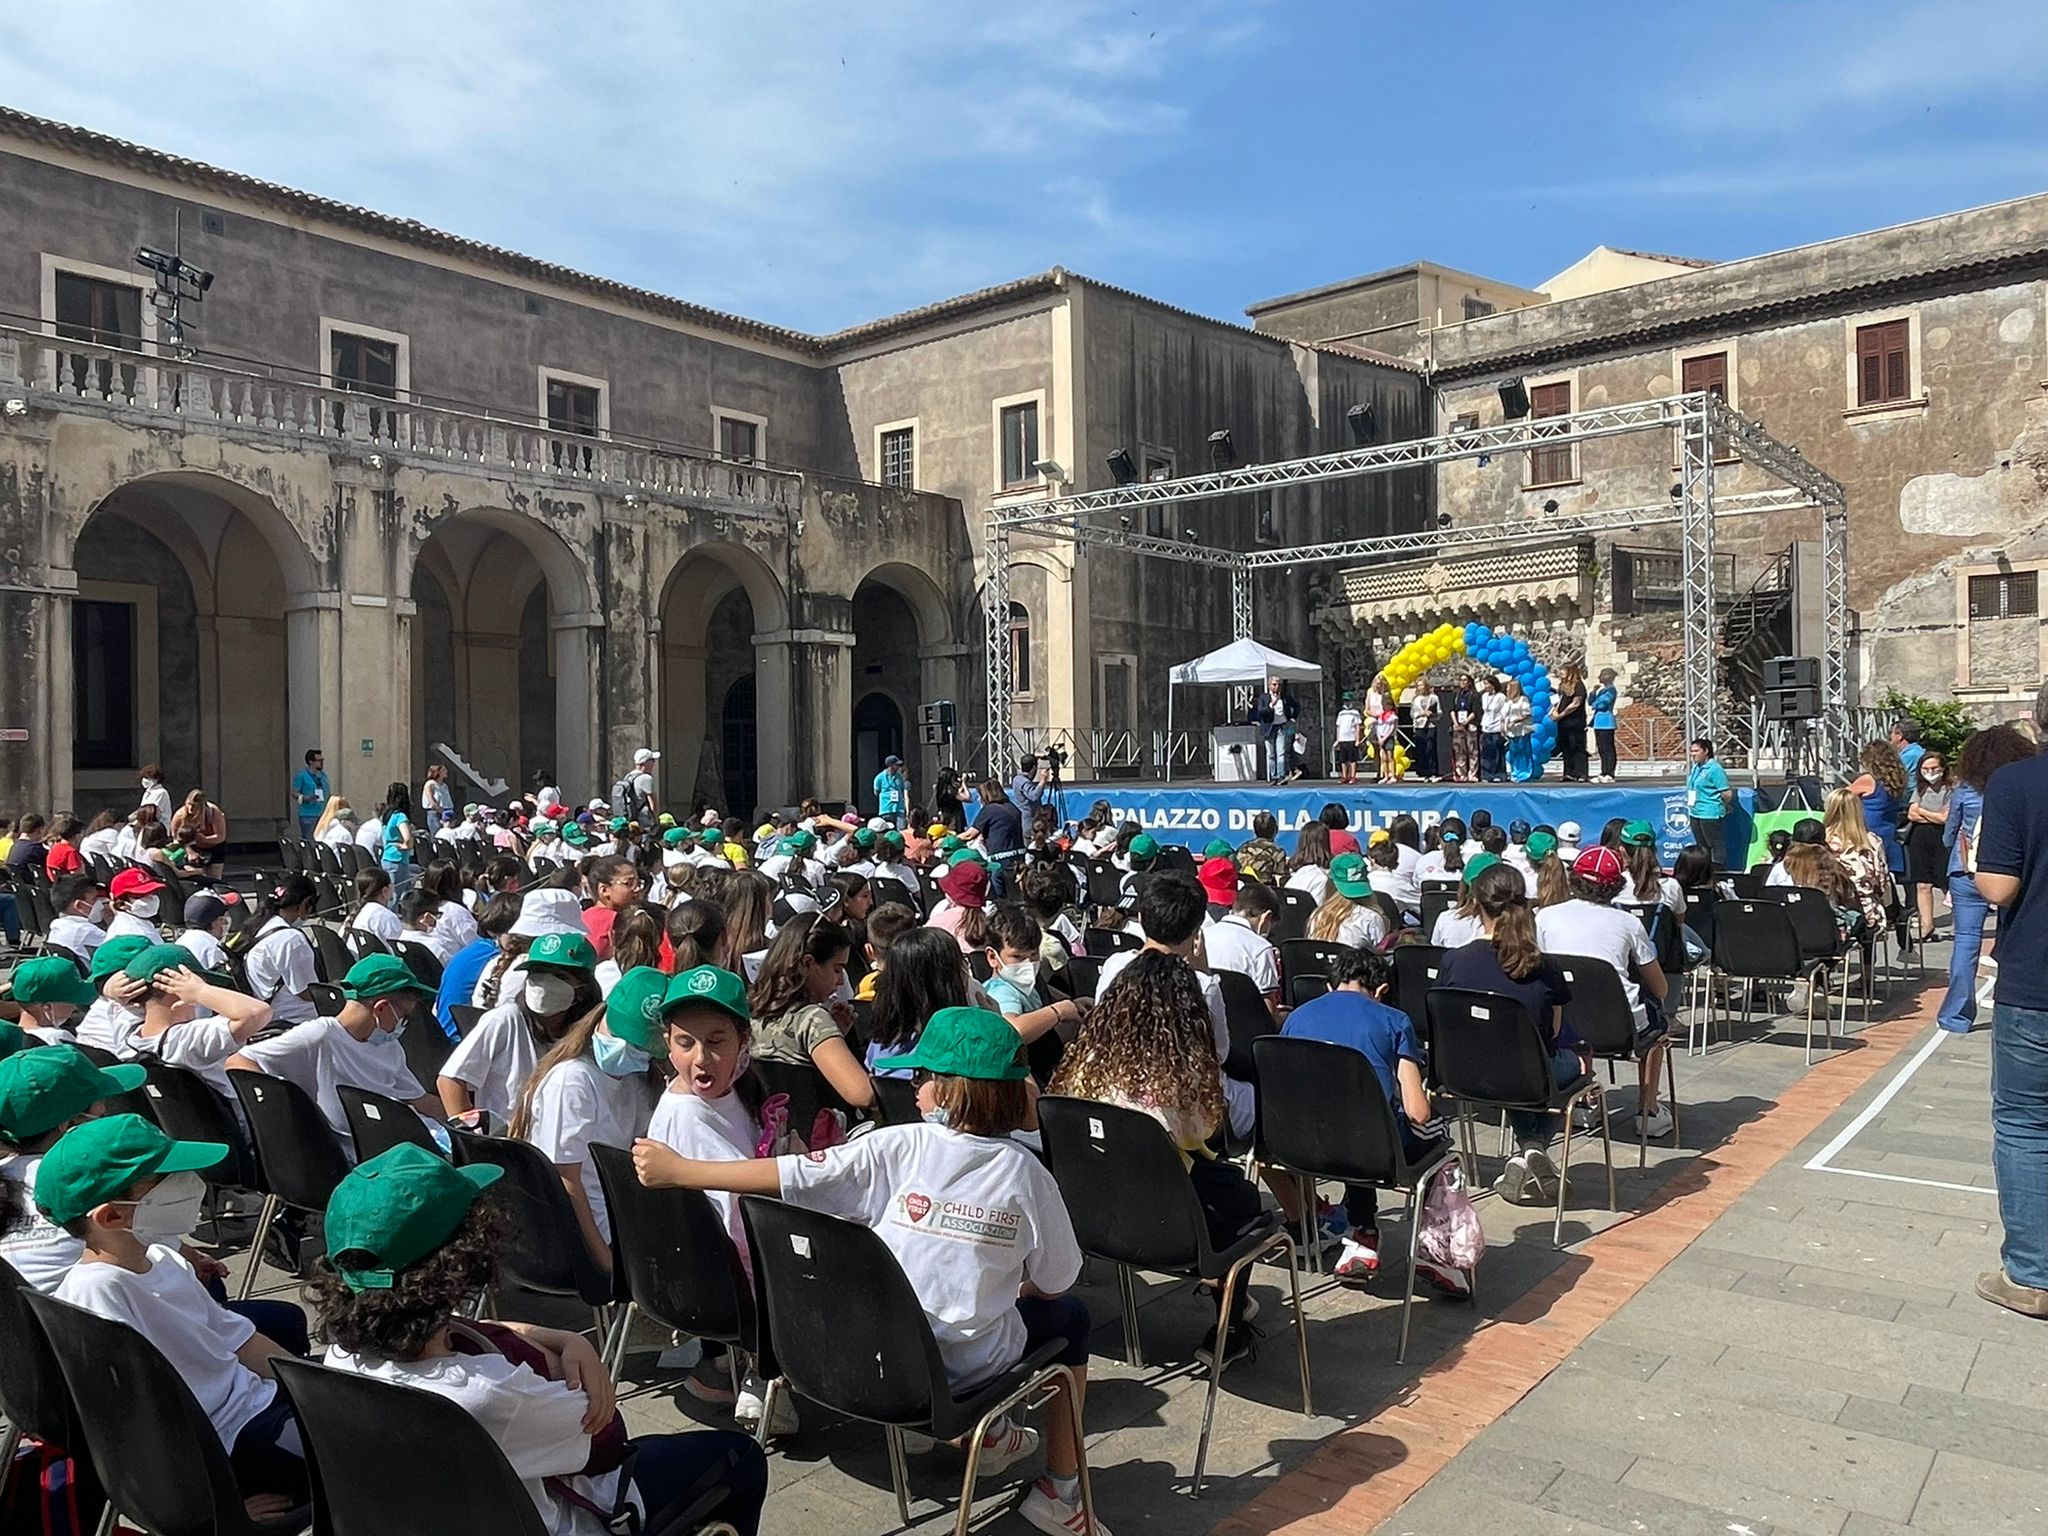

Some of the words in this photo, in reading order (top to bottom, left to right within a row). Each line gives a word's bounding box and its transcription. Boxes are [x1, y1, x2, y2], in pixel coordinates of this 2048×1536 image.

[1112, 808, 1220, 830] PALAZZO
[1228, 808, 1311, 831] DELA
[908, 1197, 929, 1208] CHILD
[908, 1204, 928, 1215] FIRST
[943, 1202, 985, 1219] CHILD
[988, 1209, 1021, 1226] FIRST
[942, 1218, 1015, 1239] ASSOCIAZIONE
